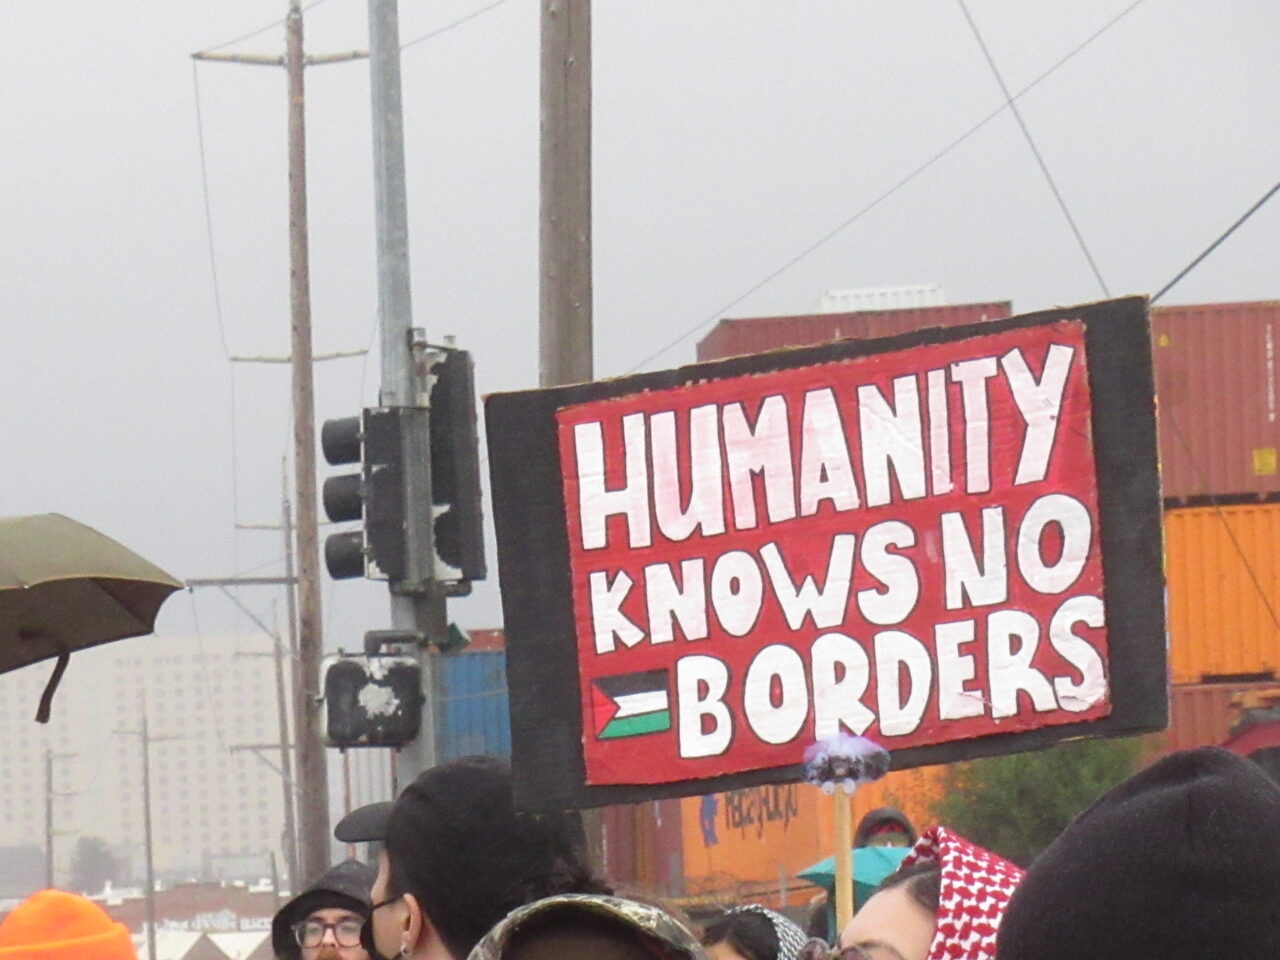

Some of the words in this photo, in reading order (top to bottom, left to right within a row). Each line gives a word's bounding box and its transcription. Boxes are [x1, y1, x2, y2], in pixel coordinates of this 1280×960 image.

[573, 343, 1075, 550] HUMANITY
[588, 520, 919, 655] KNOWS
[941, 493, 1092, 610] NO
[676, 595, 1108, 759] BORDERS
